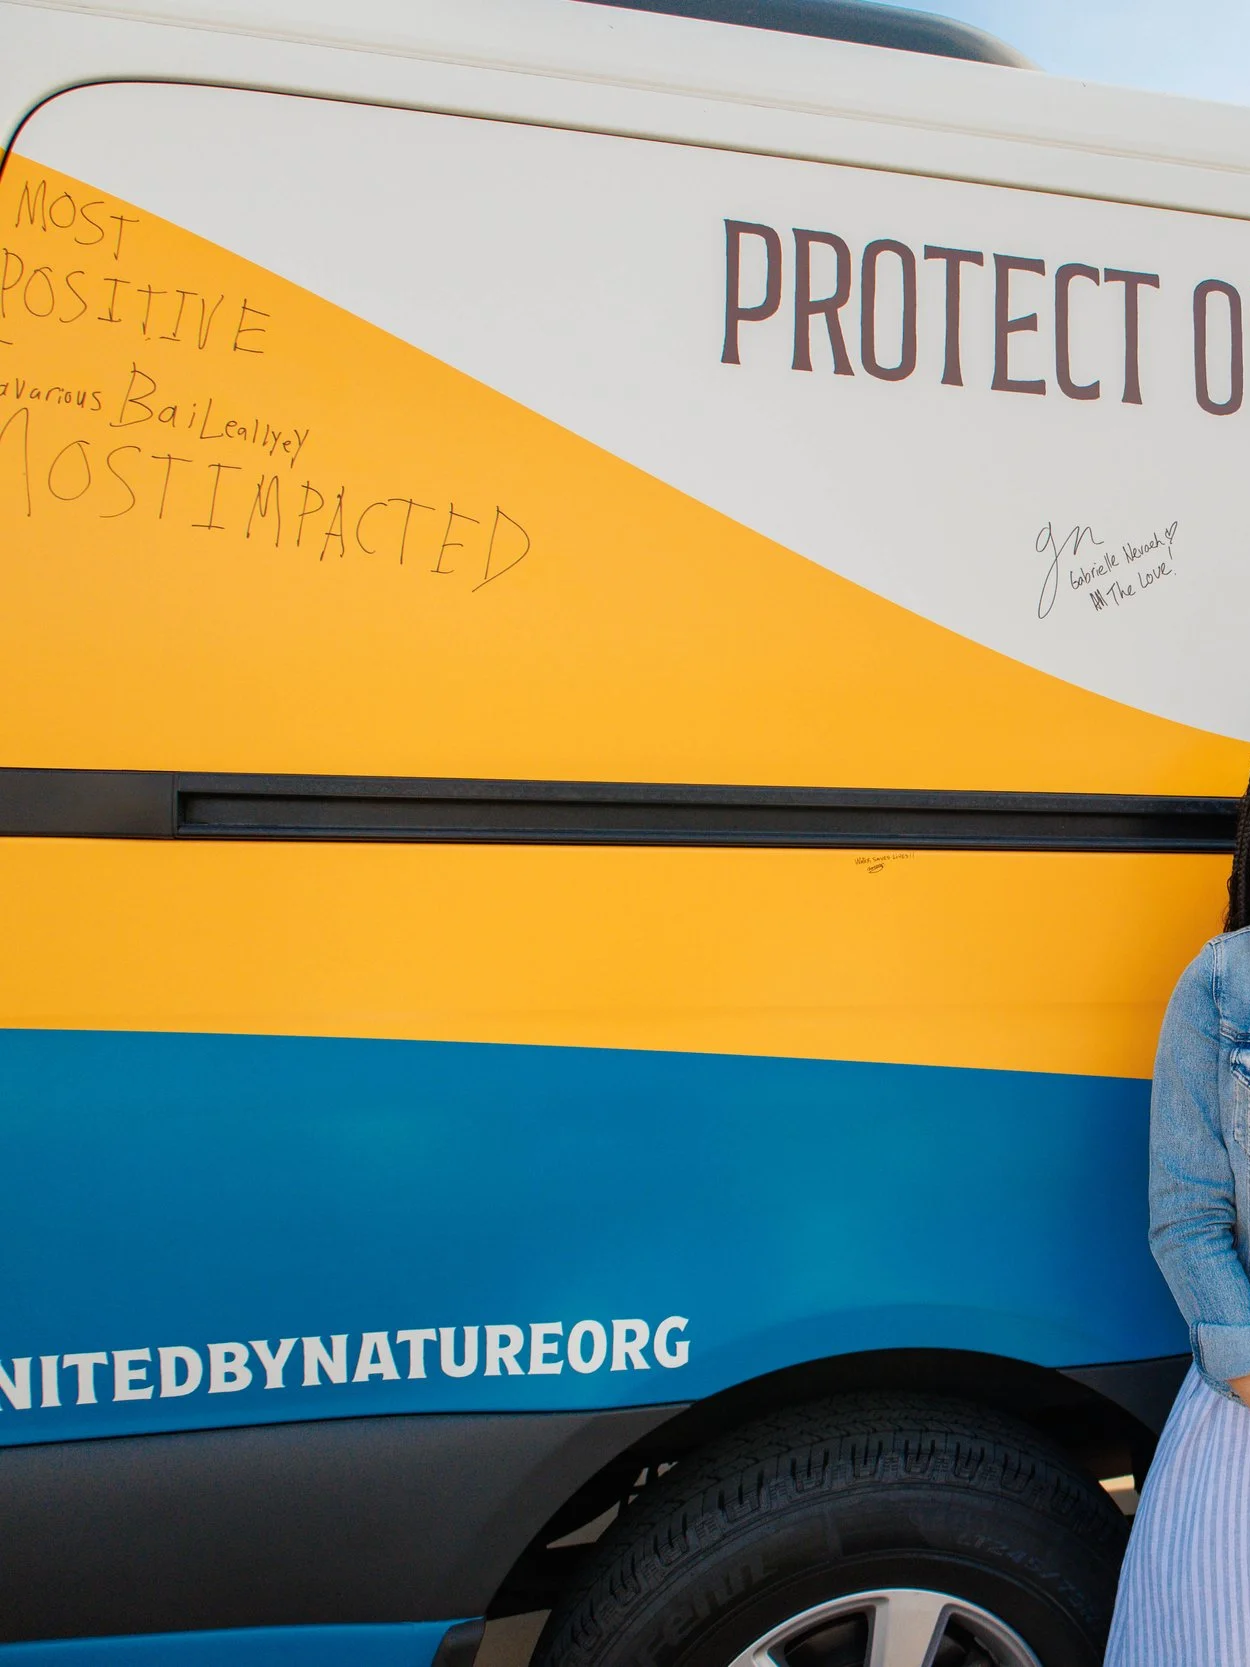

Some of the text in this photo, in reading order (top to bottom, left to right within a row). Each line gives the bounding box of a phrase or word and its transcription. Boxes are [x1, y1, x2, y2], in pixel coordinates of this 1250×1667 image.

[15, 179, 140, 260] MOST
[0, 248, 271, 353] POSITIVE
[721, 219, 1160, 404] PROTECT
[1070, 552, 1119, 590] Gabrielle
[1106, 581, 1136, 606] The
